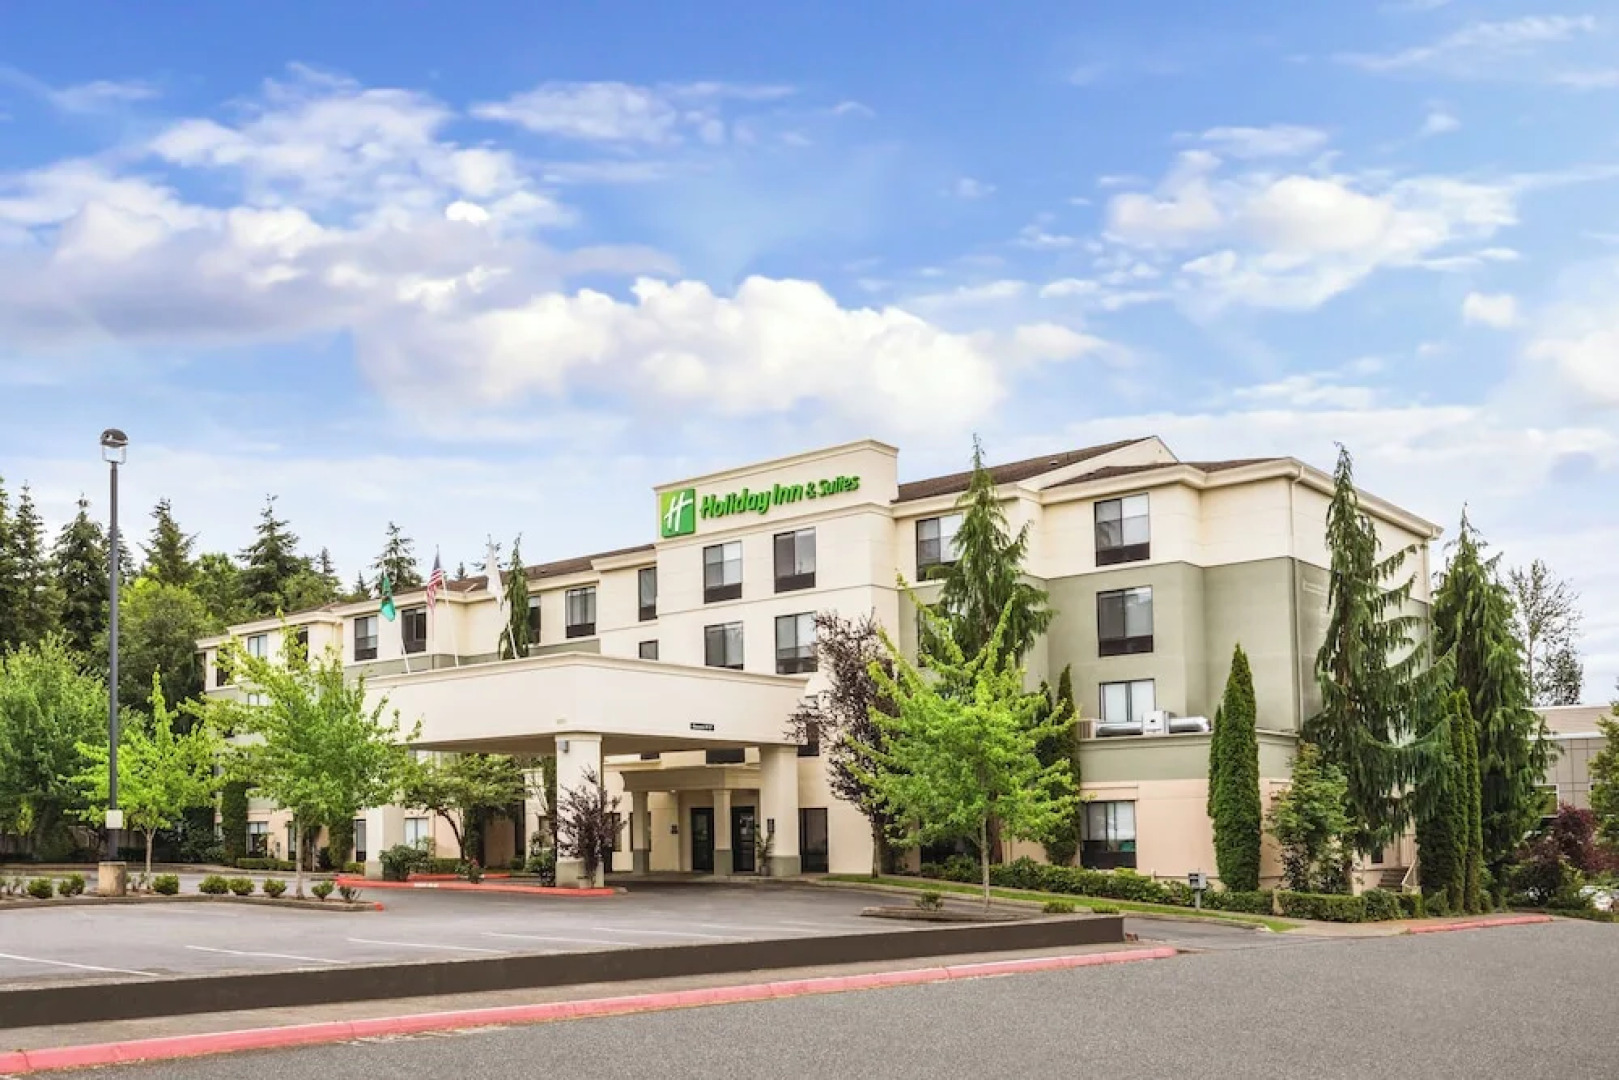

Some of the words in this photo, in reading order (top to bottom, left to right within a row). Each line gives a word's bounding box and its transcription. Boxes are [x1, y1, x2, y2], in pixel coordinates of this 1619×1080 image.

[700, 488, 771, 519] Holiday
[773, 483, 803, 506] Inn
[805, 481, 817, 499] &
[818, 475, 860, 497] Suites
